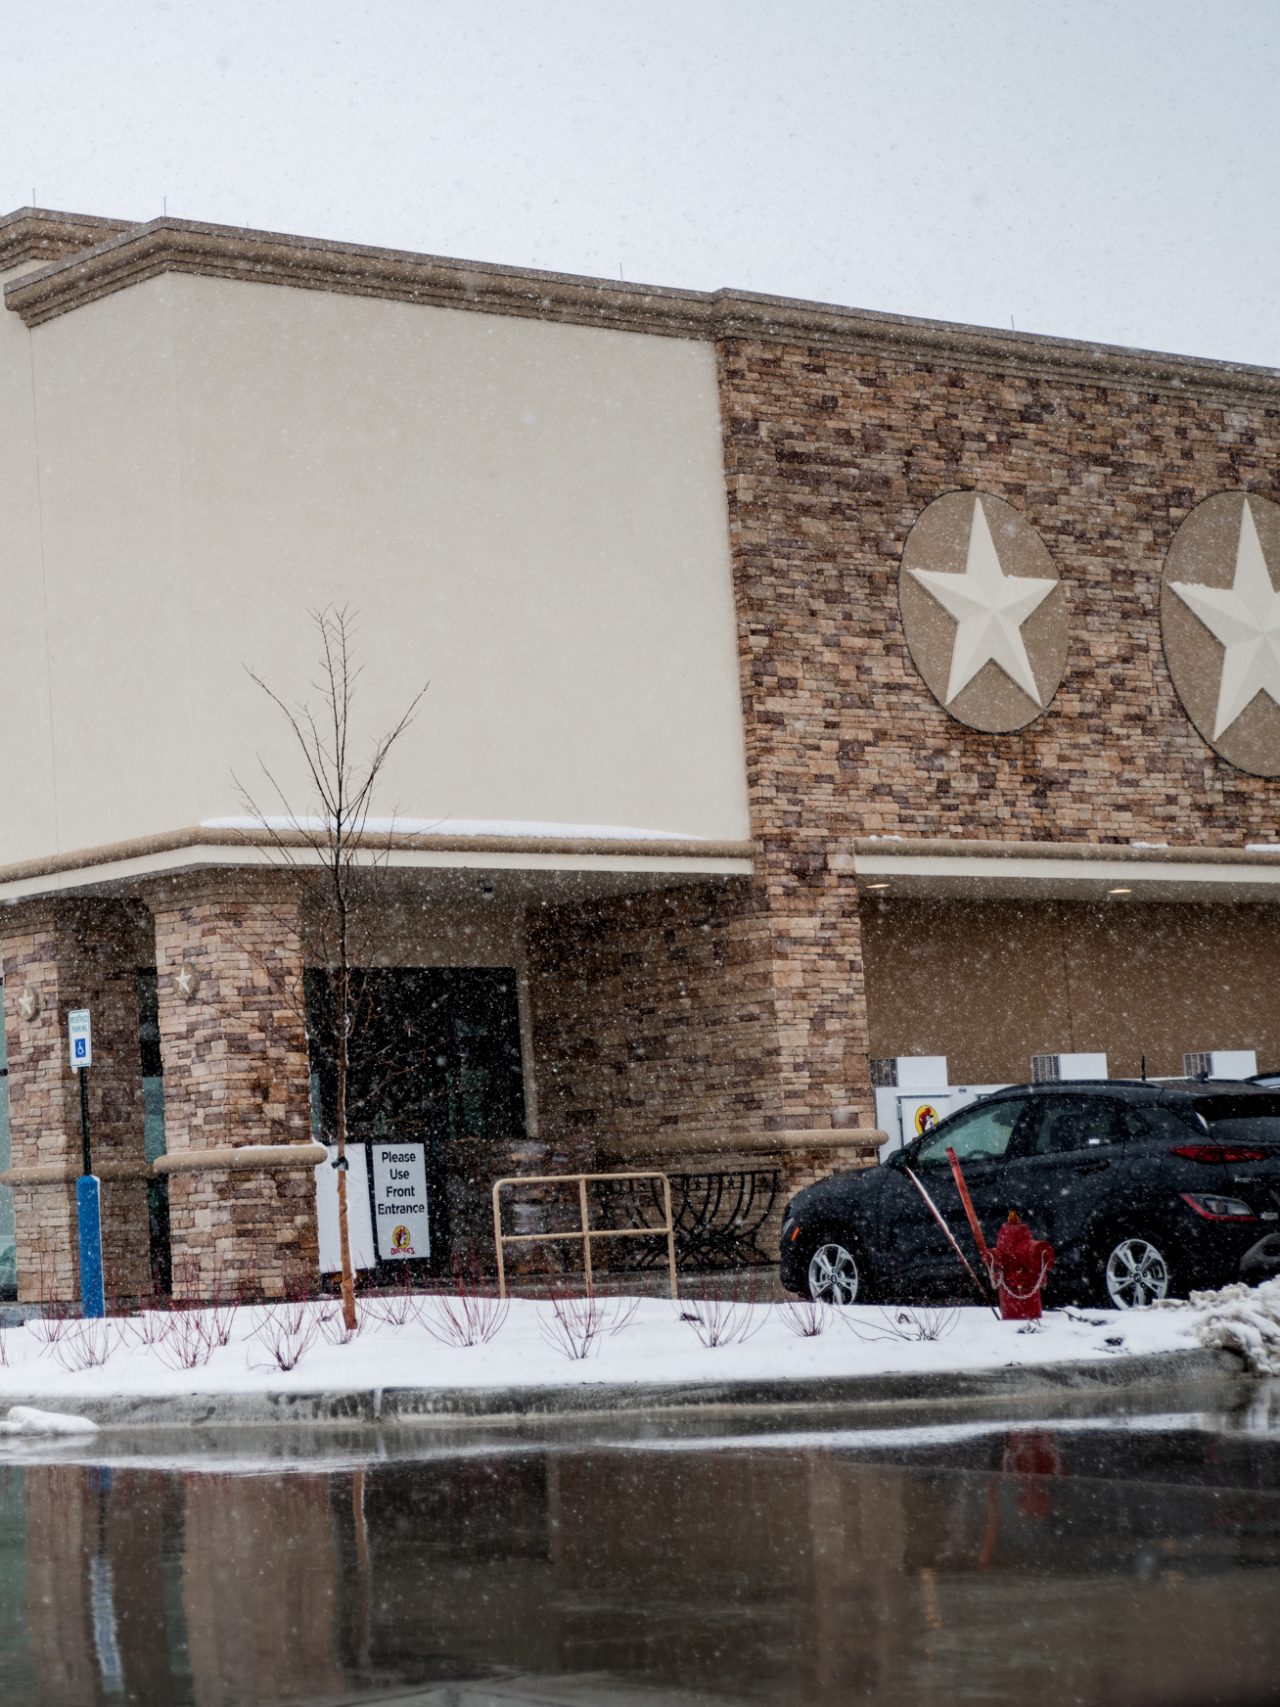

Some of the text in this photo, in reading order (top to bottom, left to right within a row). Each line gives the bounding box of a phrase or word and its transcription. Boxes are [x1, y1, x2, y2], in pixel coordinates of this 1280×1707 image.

[381, 1151, 416, 1163] Please
[390, 1168, 410, 1180] Use
[386, 1186, 416, 1196] Front
[378, 1203, 425, 1215] Entrance
